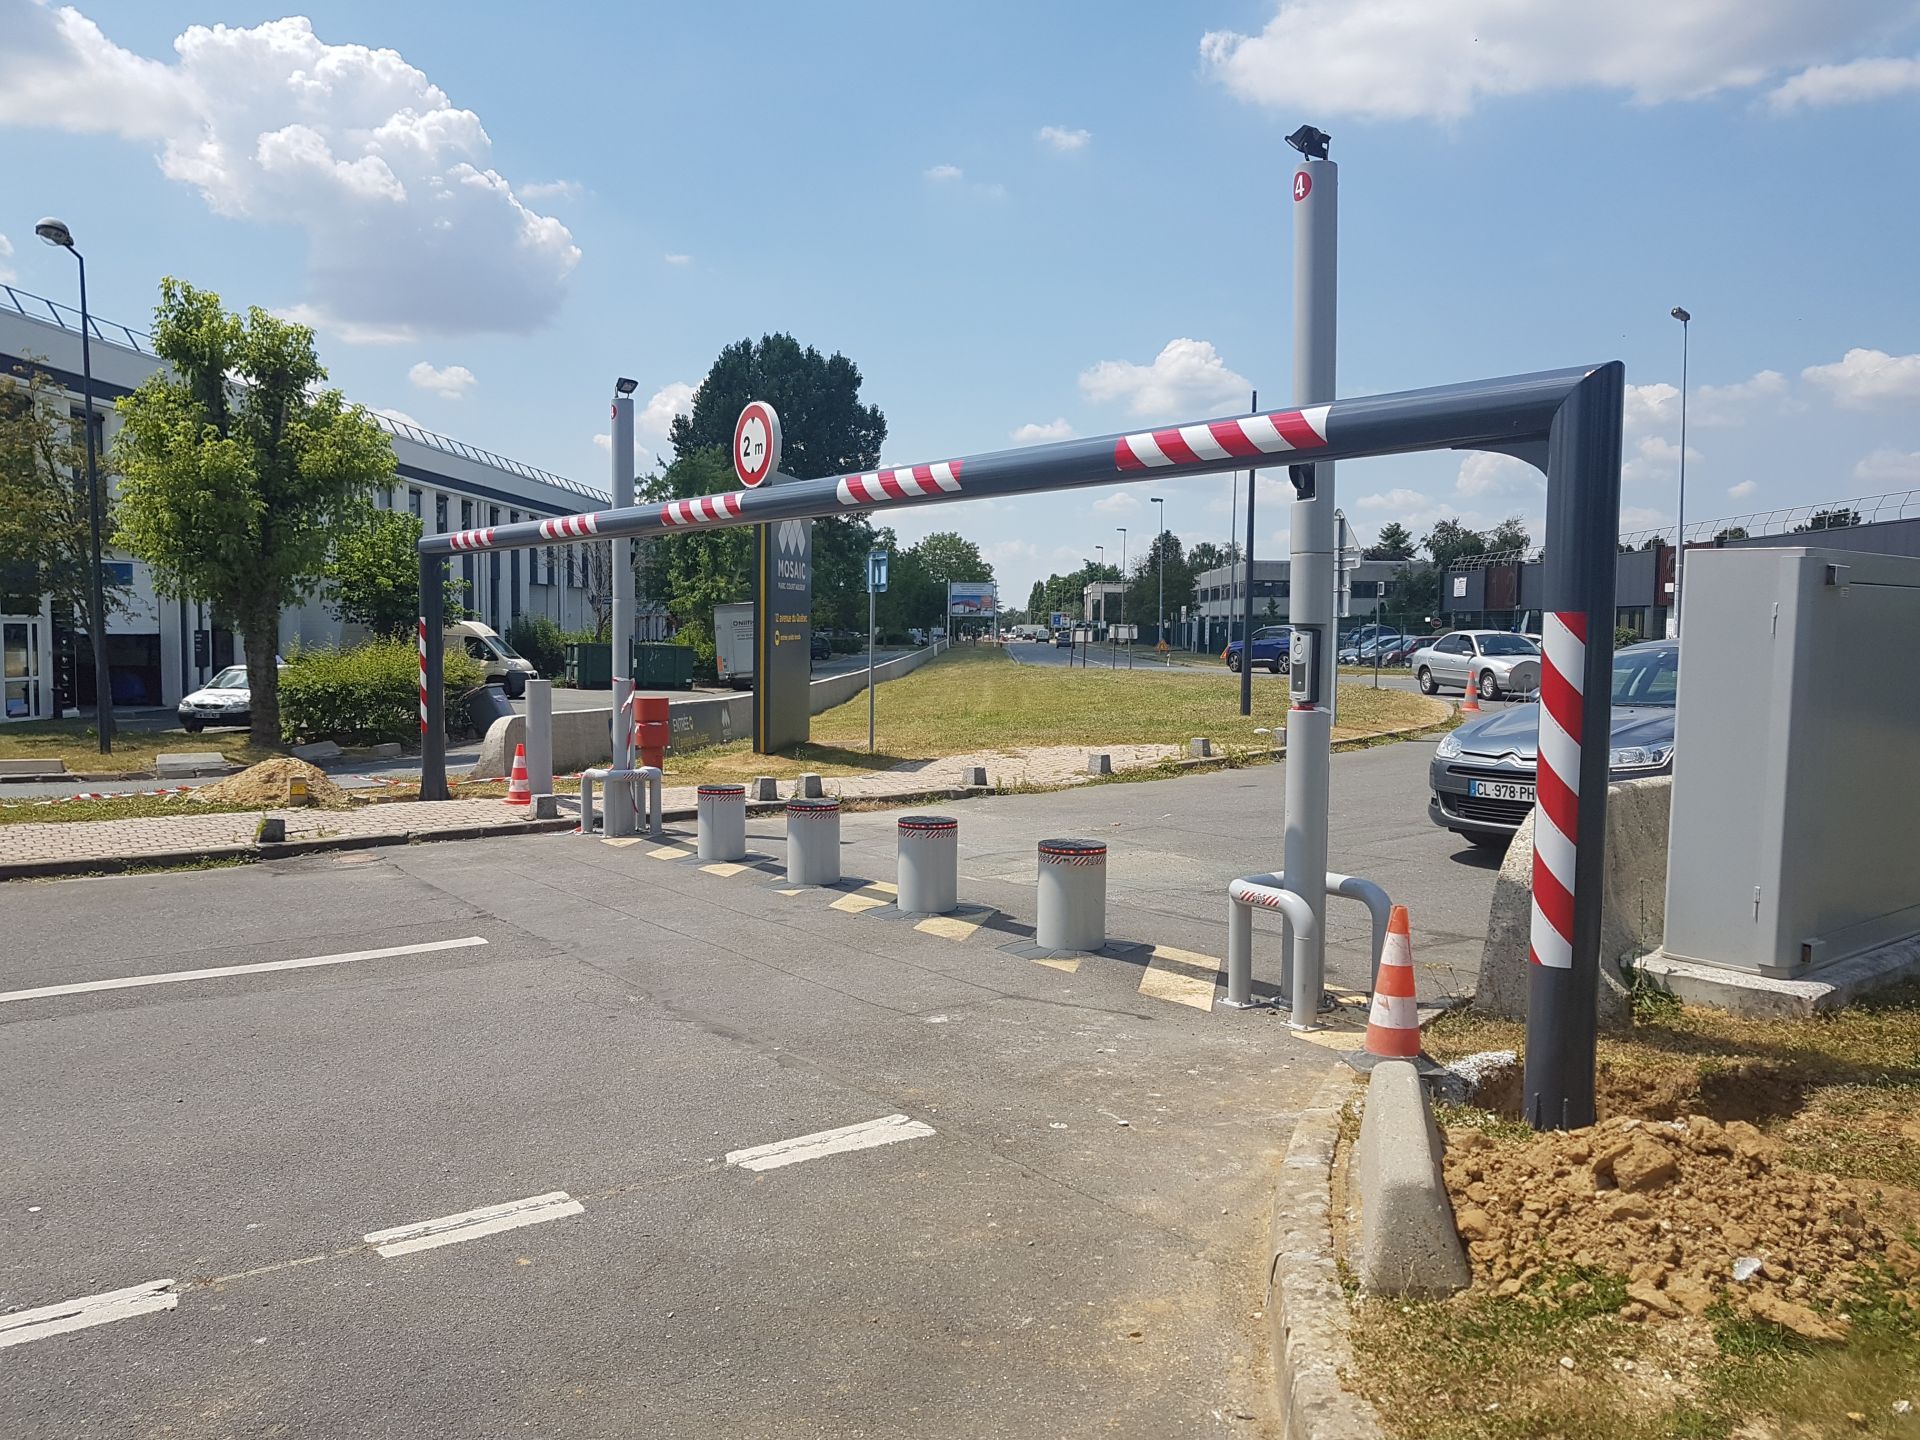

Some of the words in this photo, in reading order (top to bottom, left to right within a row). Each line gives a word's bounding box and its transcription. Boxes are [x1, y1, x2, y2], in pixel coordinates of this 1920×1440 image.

[1295, 175, 1305, 197] 4
[744, 436, 750, 457] 2
[755, 443, 763, 455] m
[778, 559, 806, 580] MOSAIC
